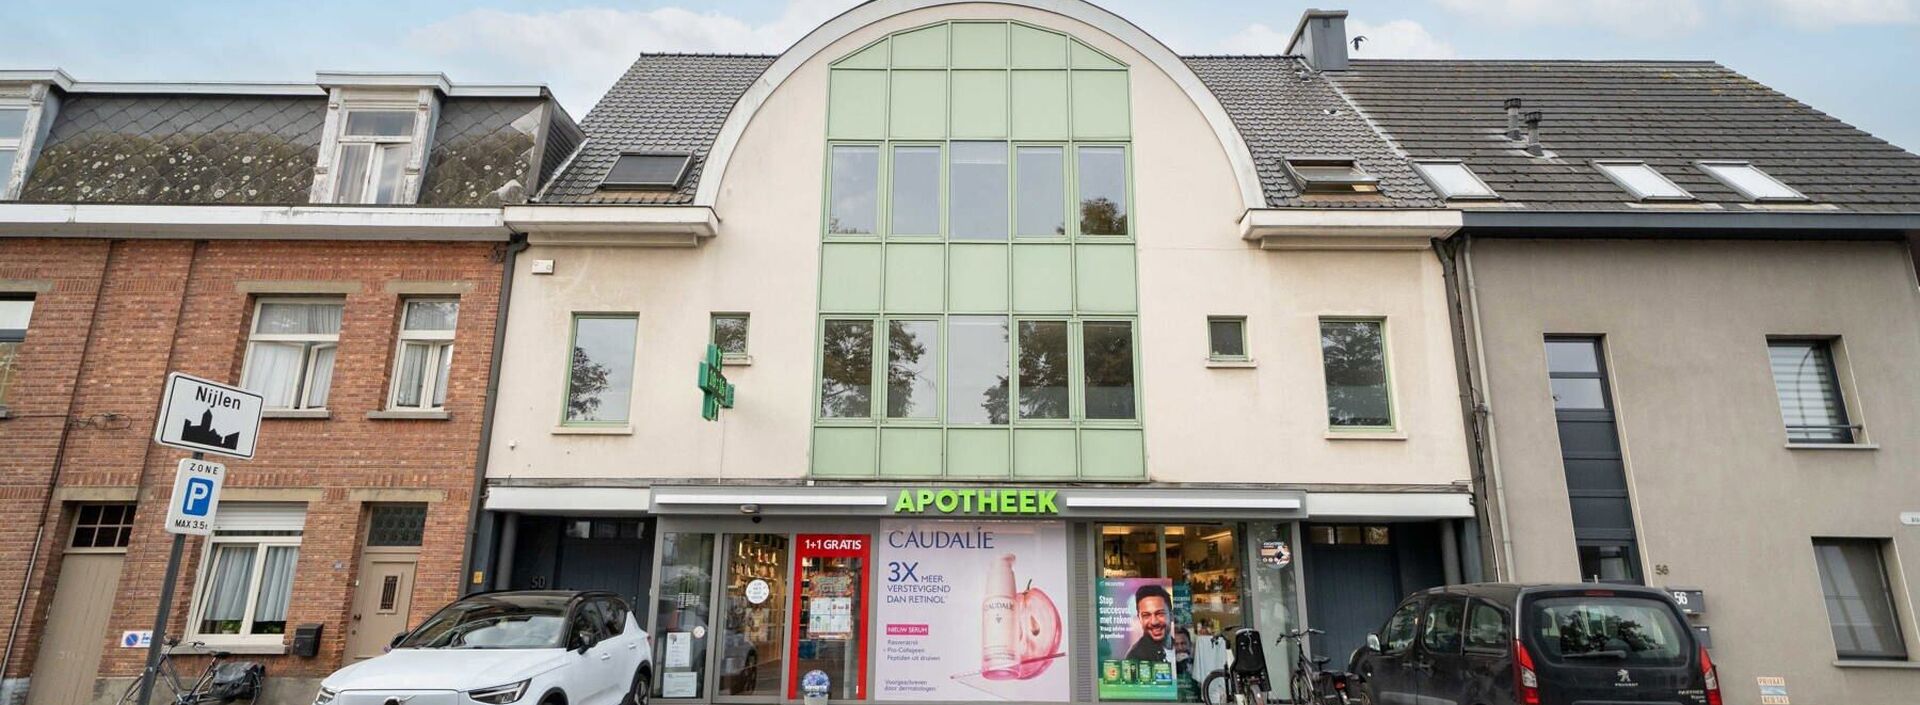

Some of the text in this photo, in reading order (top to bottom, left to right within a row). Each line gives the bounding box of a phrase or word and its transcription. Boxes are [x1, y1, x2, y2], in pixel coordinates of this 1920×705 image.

[196, 386, 241, 410] Nijlen
[189, 462, 219, 475] ZONE
[186, 482, 209, 511] P
[894, 489, 1059, 514] APOTHEEK
[174, 519, 191, 529] MAX
[805, 539, 862, 550] 1+1 GRATIS
[888, 561, 944, 583] 3X MEER
[1655, 564, 1669, 575] 56
[531, 576, 546, 589] 50
[887, 584, 951, 593] VERSTEVIGEND
[887, 595, 946, 604] DAN RETINOL
[1099, 595, 1114, 606] Stop
[1674, 591, 1688, 605] 56
